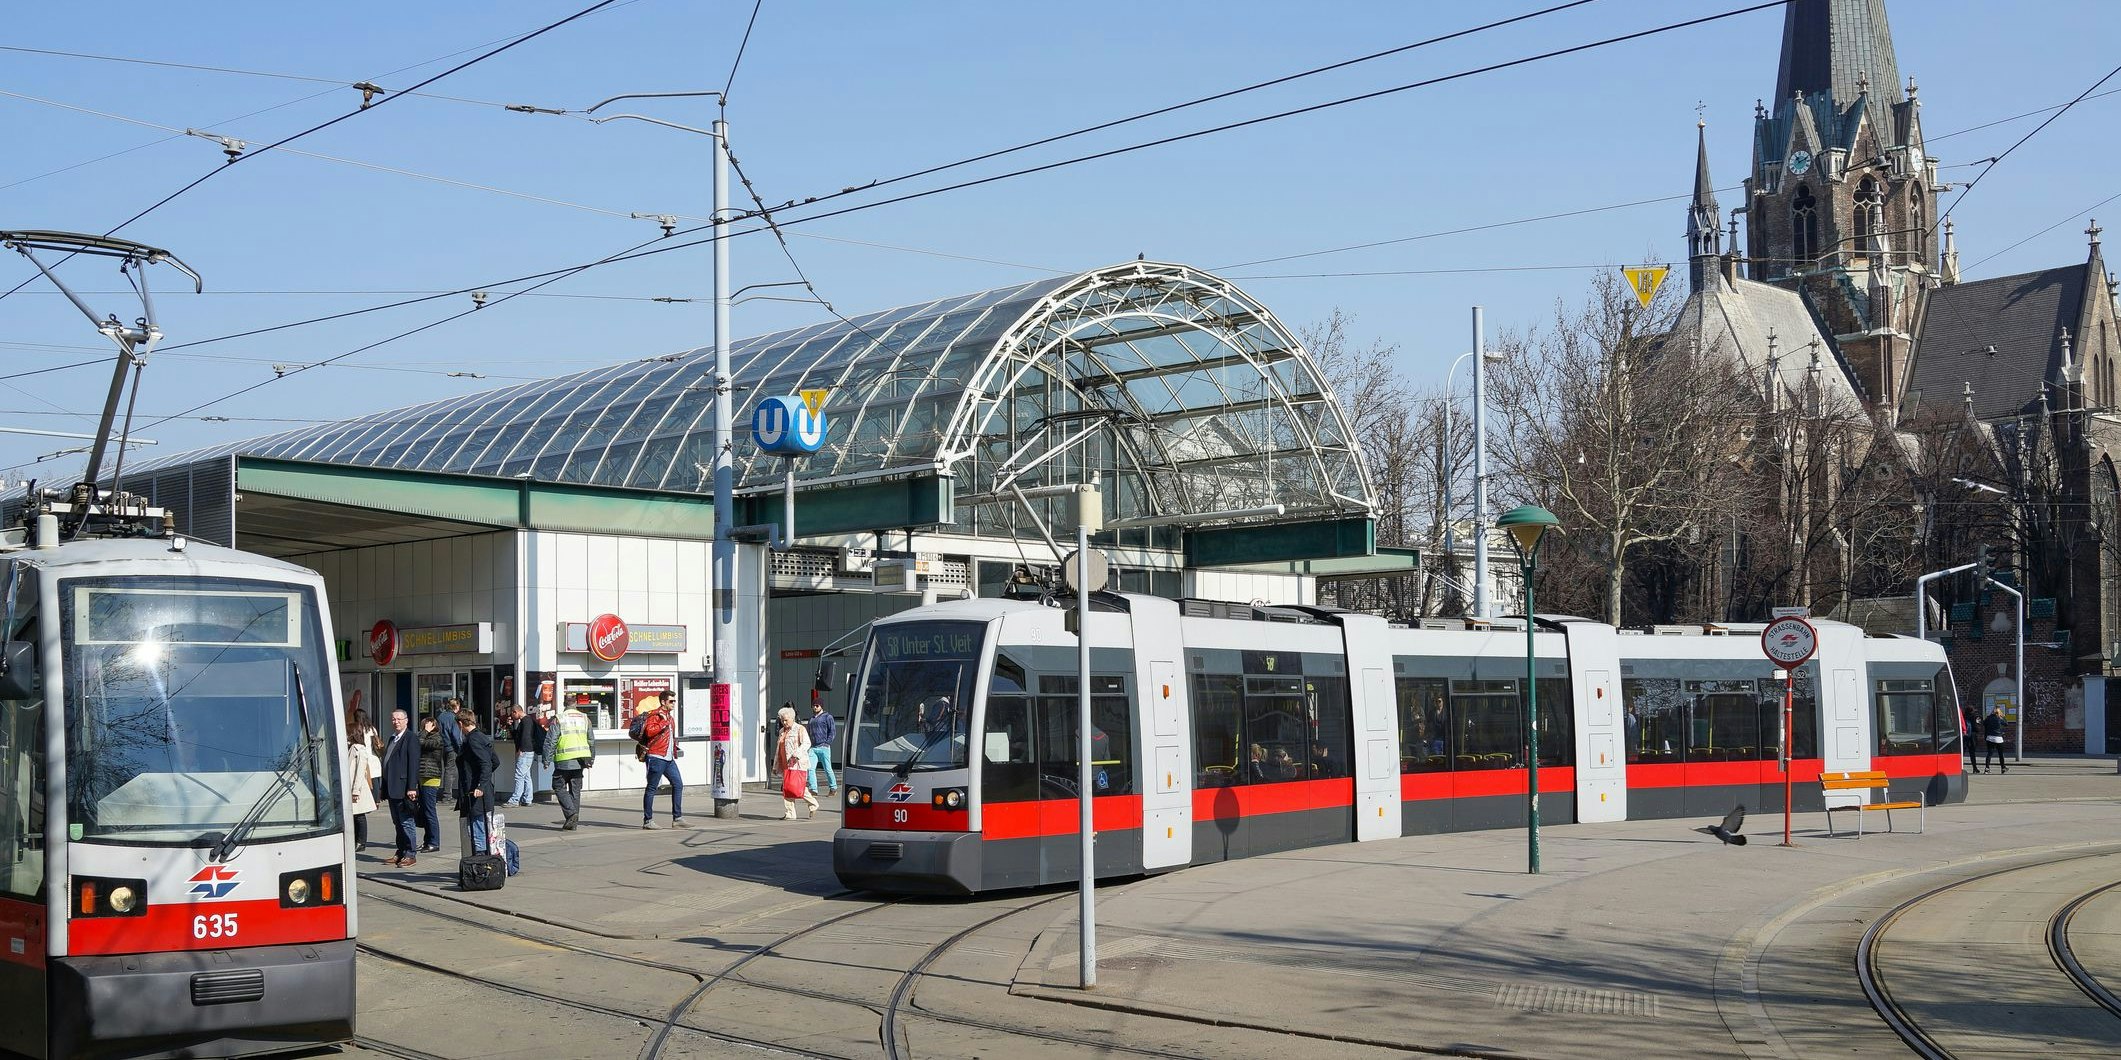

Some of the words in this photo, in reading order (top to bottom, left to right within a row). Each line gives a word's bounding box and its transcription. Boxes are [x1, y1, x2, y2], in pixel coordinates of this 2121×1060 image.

[758, 408, 783, 444] U
[799, 408, 822, 446] U
[404, 630, 472, 649] SCHNELLIMBISS
[629, 631, 683, 643] SCHNELLIMBISS
[1031, 628, 1041, 641] 90
[1769, 622, 1811, 640] STRASSENBAHN
[902, 635, 930, 655] Unter
[934, 634, 948, 654] St.
[950, 633, 972, 653] Veit
[1770, 646, 1809, 660] HALTESTELLE
[1266, 657, 1274, 671] 58
[893, 809, 908, 822] 90
[193, 913, 239, 939] 635
